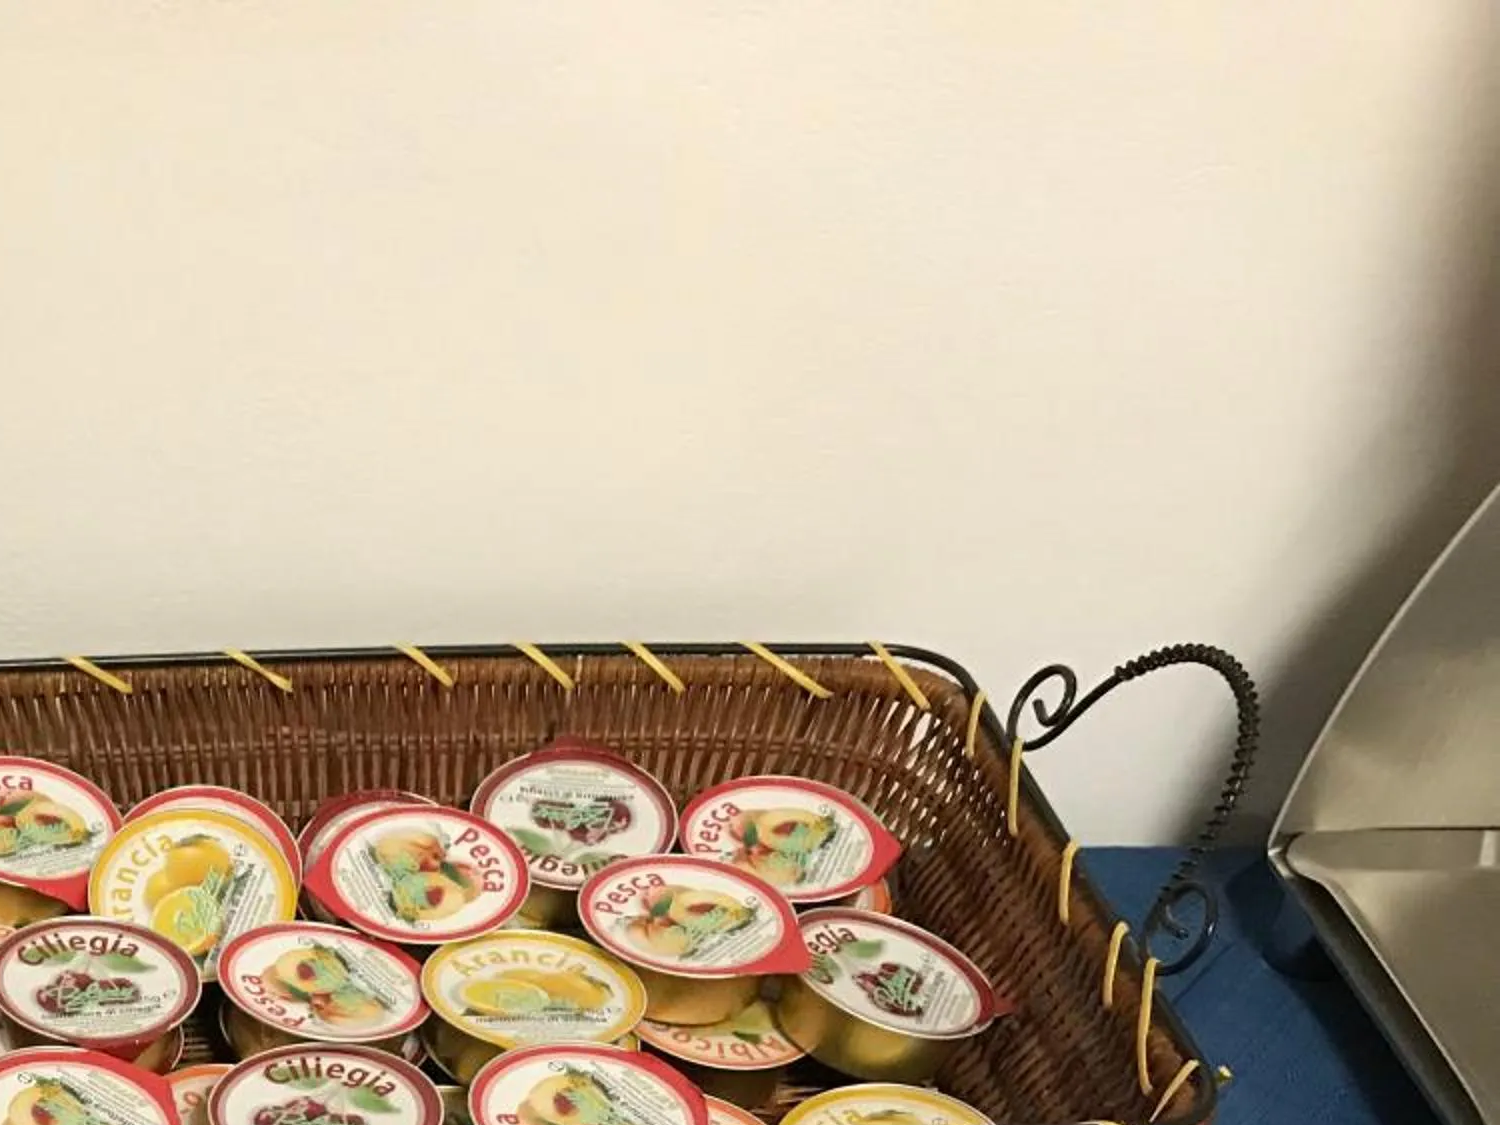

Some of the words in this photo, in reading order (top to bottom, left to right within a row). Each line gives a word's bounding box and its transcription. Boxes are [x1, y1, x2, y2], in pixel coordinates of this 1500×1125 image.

[694, 801, 741, 853] Pesca
[111, 833, 174, 921] rancia
[454, 827, 505, 893] Pesca
[595, 872, 666, 916] Pesca
[17, 932, 140, 966] Ciliegia
[451, 948, 588, 977] Arancia
[241, 975, 305, 1028] Pesca
[263, 1056, 397, 1097] Ciliegia
